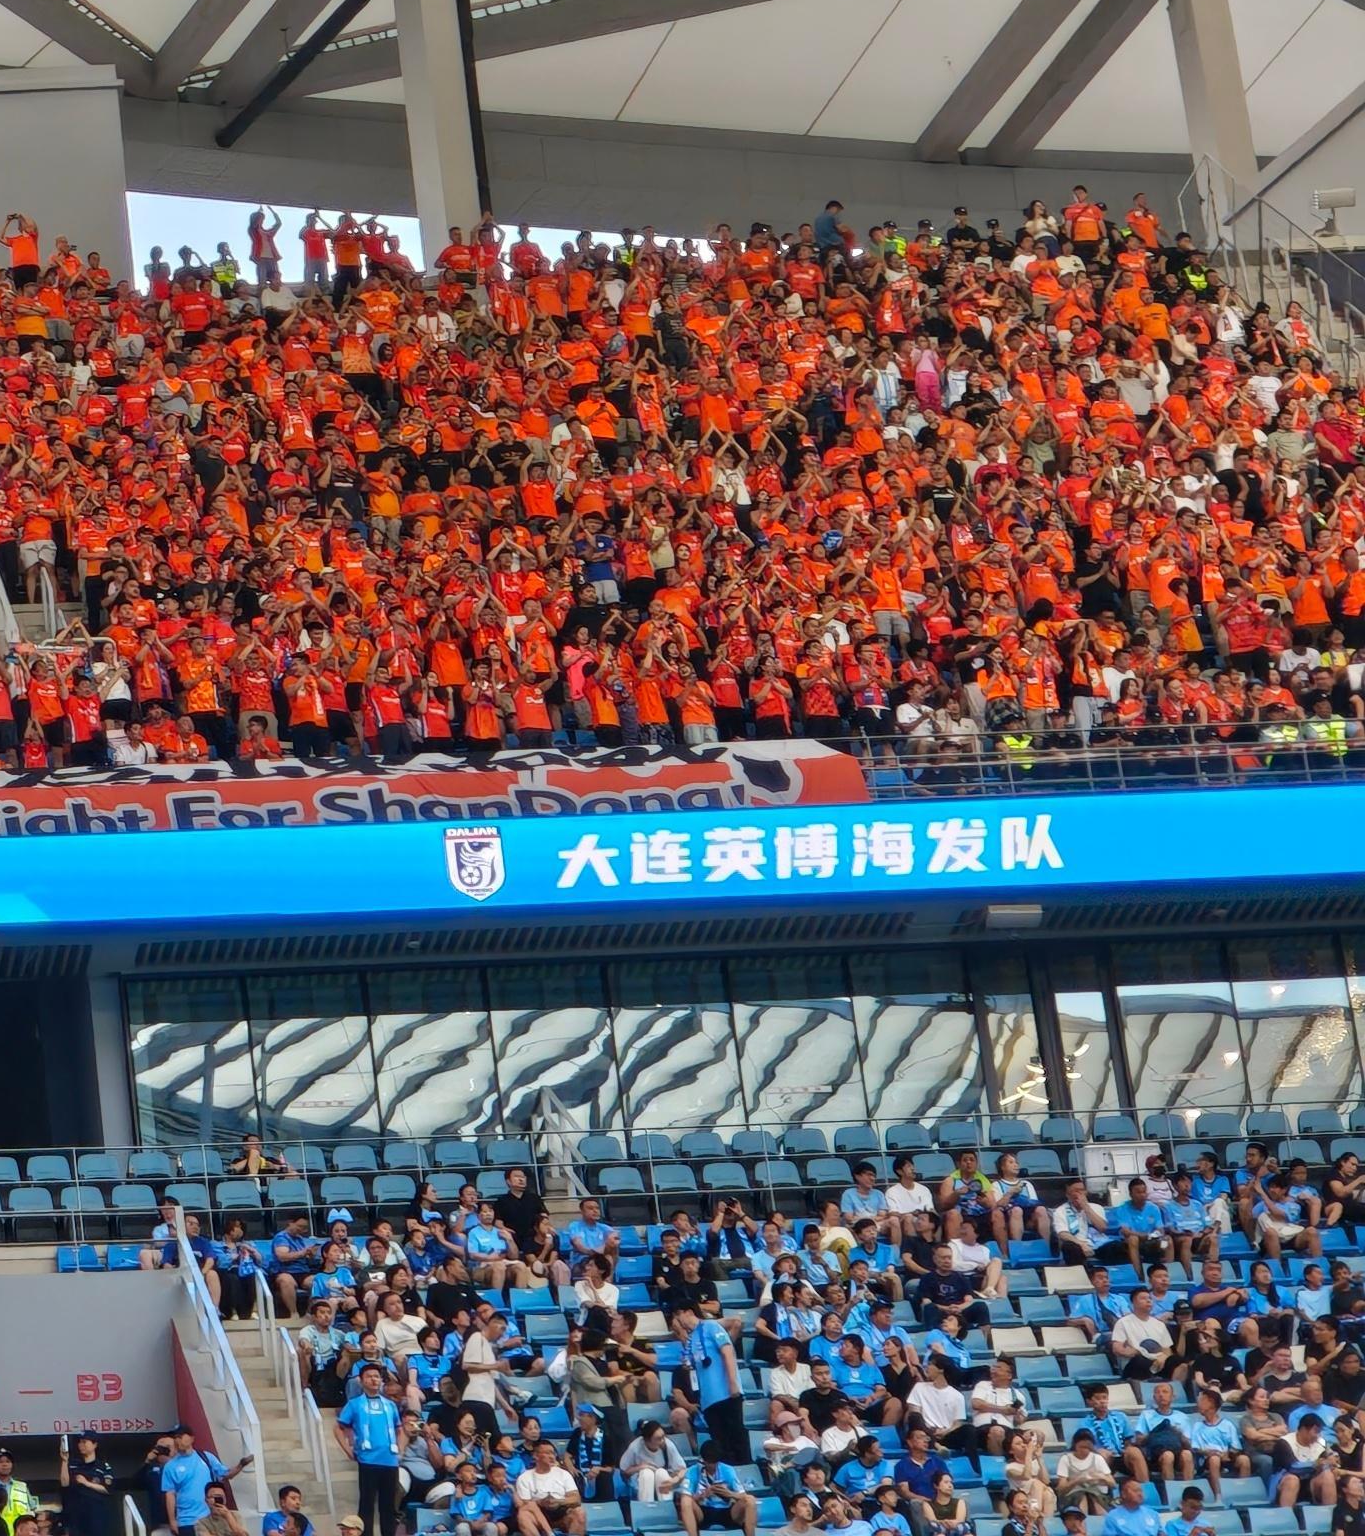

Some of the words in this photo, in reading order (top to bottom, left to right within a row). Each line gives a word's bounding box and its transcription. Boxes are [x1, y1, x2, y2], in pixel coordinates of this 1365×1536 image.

[172, 795, 297, 831] For
[446, 826, 498, 837] DALIAN
[556, 813, 1065, 889] 大连英博海发队
[76, 1373, 123, 1402] B3
